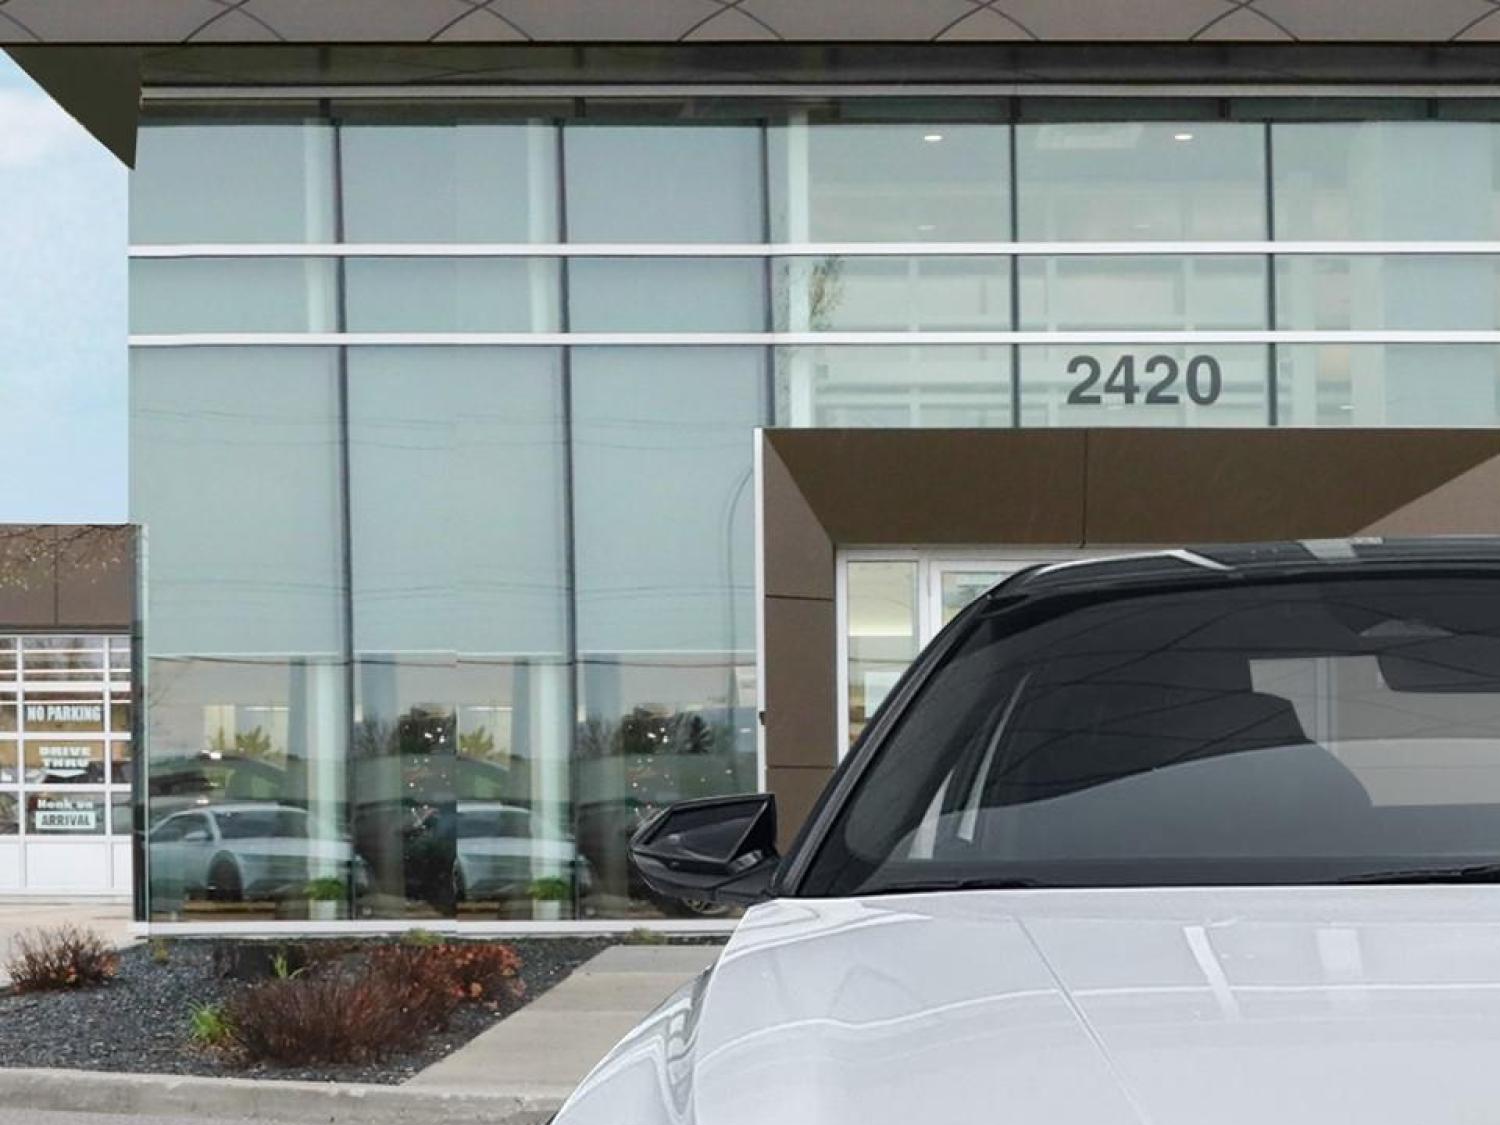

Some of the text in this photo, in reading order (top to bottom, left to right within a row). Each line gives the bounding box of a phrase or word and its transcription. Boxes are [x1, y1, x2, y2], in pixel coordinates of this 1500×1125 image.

[1066, 354, 1223, 406] 2420
[26, 706, 102, 721] NO PARKING
[39, 746, 91, 756] DRIVE
[41, 814, 91, 826] ARRIVAL
